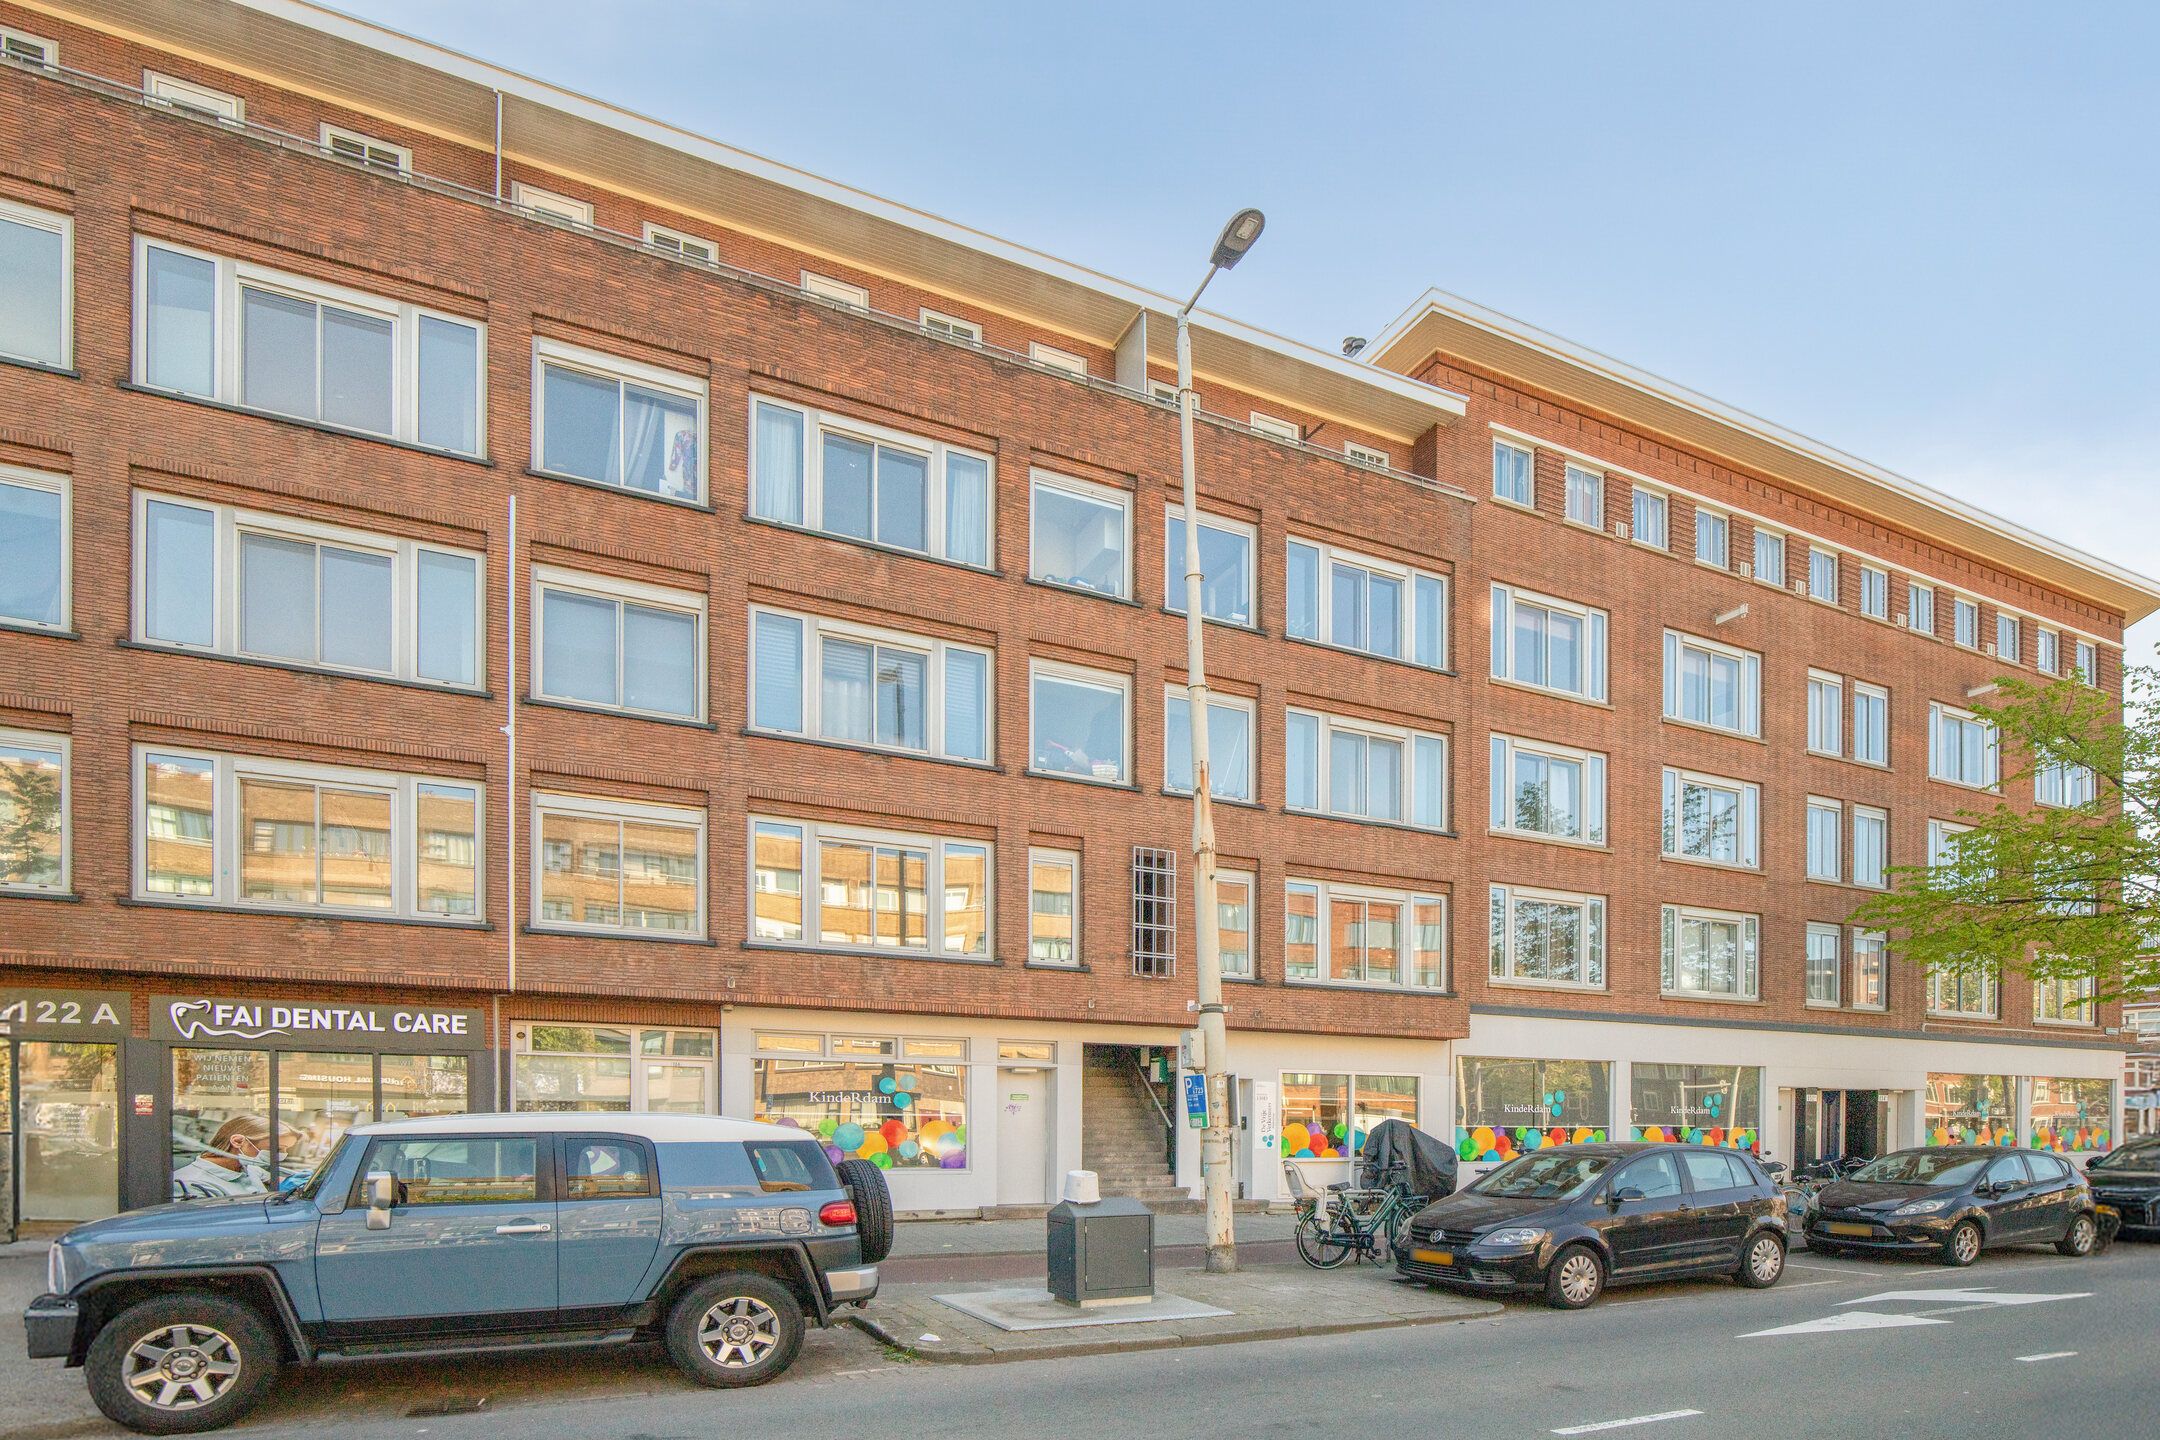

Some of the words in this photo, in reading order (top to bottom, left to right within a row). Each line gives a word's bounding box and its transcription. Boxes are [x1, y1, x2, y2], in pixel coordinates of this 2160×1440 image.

[91, 1003, 120, 1025] A
[215, 1005, 262, 1027] FAI
[272, 1007, 386, 1032] DENTAL
[393, 1012, 467, 1035] CARE
[214, 1055, 251, 1063] NEMEN
[203, 1064, 242, 1072] NIEUWE
[1184, 1077, 1192, 1095] P
[808, 1091, 892, 1104] KindeRdam
[1504, 1104, 1551, 1113] KindeRdam
[1670, 1105, 1710, 1114] KindeRdam
